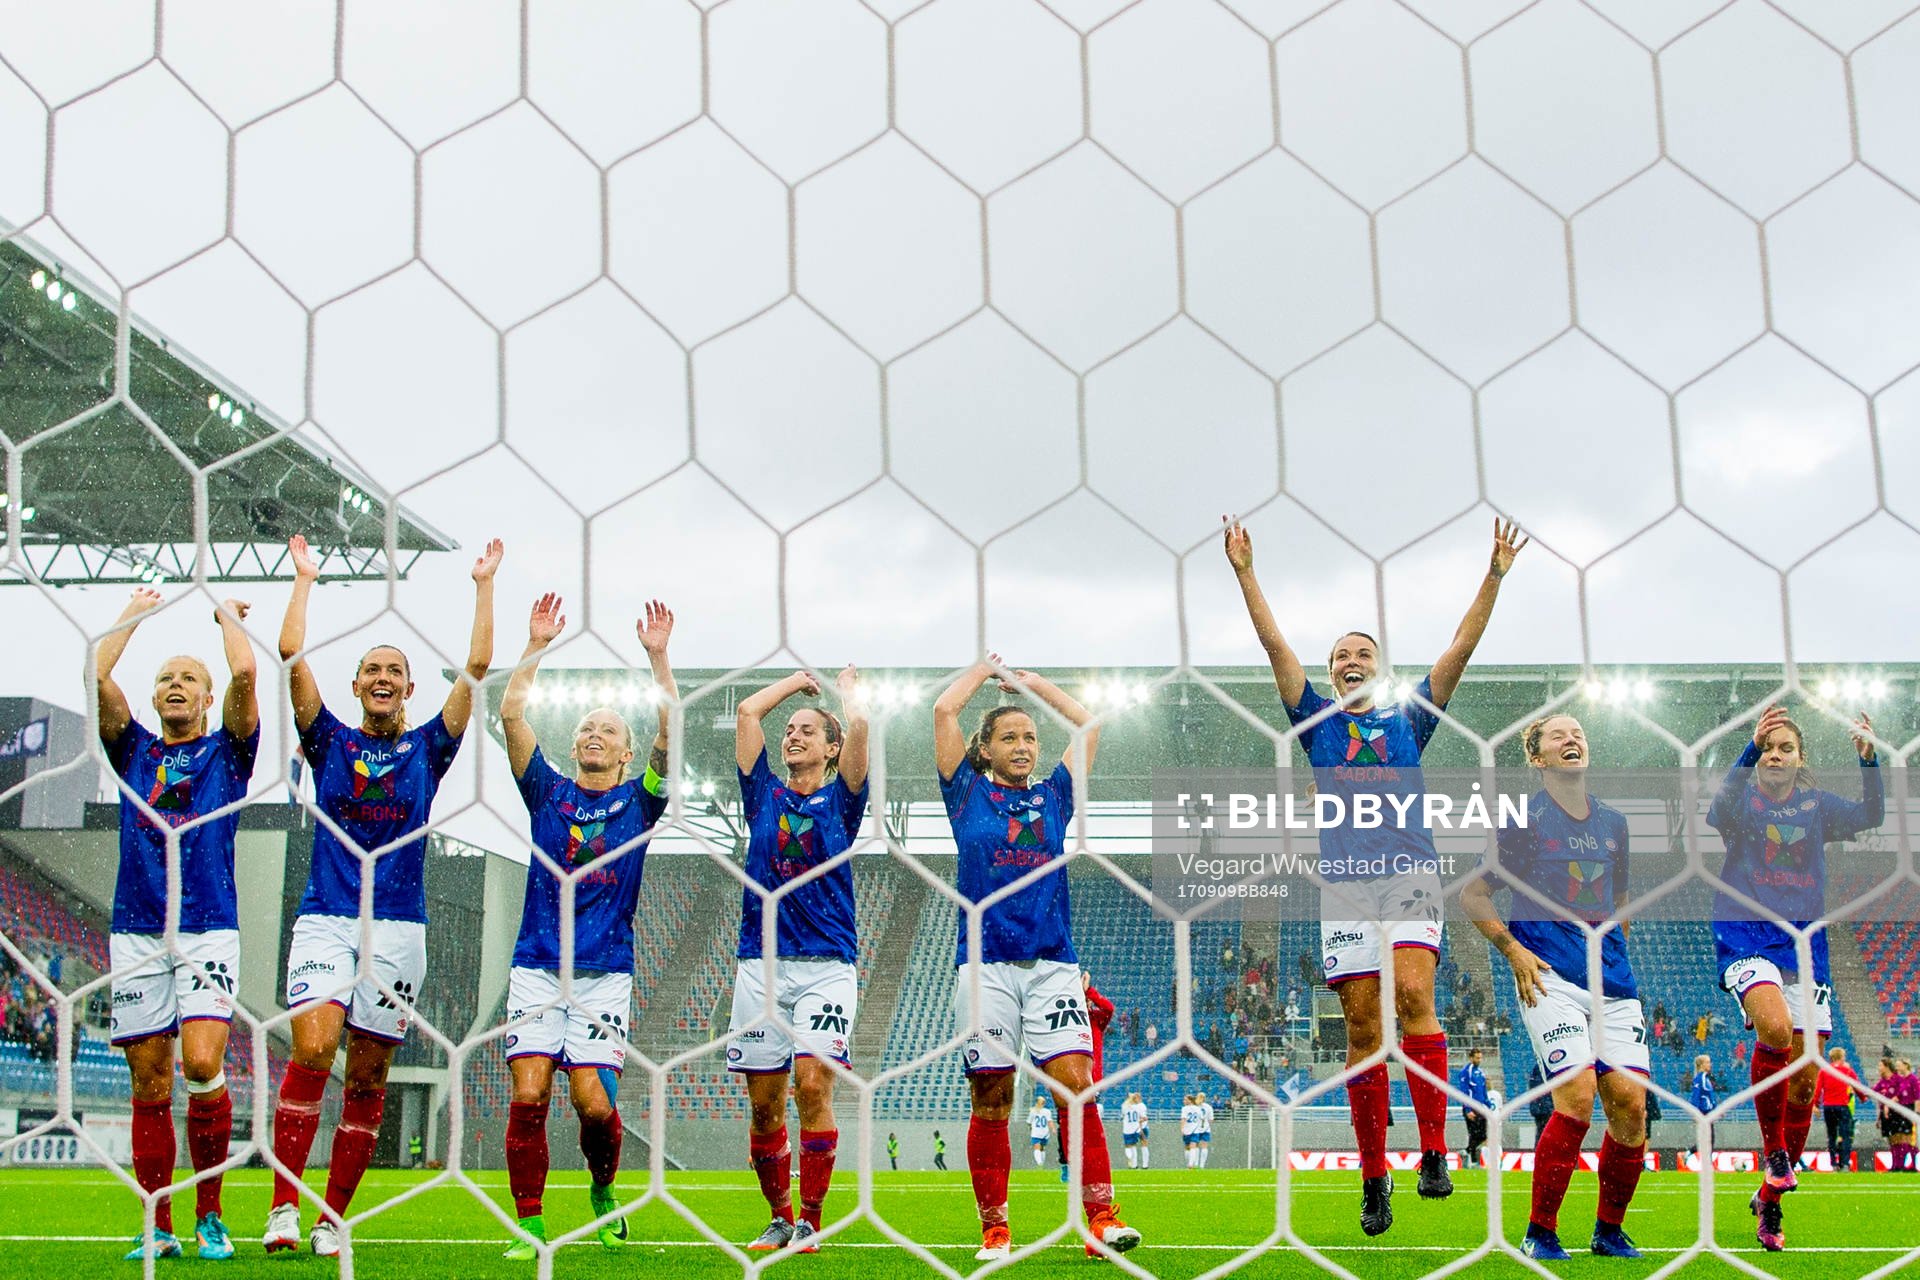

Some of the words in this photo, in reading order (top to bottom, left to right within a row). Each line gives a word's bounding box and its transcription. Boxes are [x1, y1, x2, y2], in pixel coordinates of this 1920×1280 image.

[1568, 832, 1598, 854] DNB
[1035, 1115, 1047, 1128] 20
[1127, 1111, 1138, 1123] 10
[1288, 1152, 1361, 1170] VG
